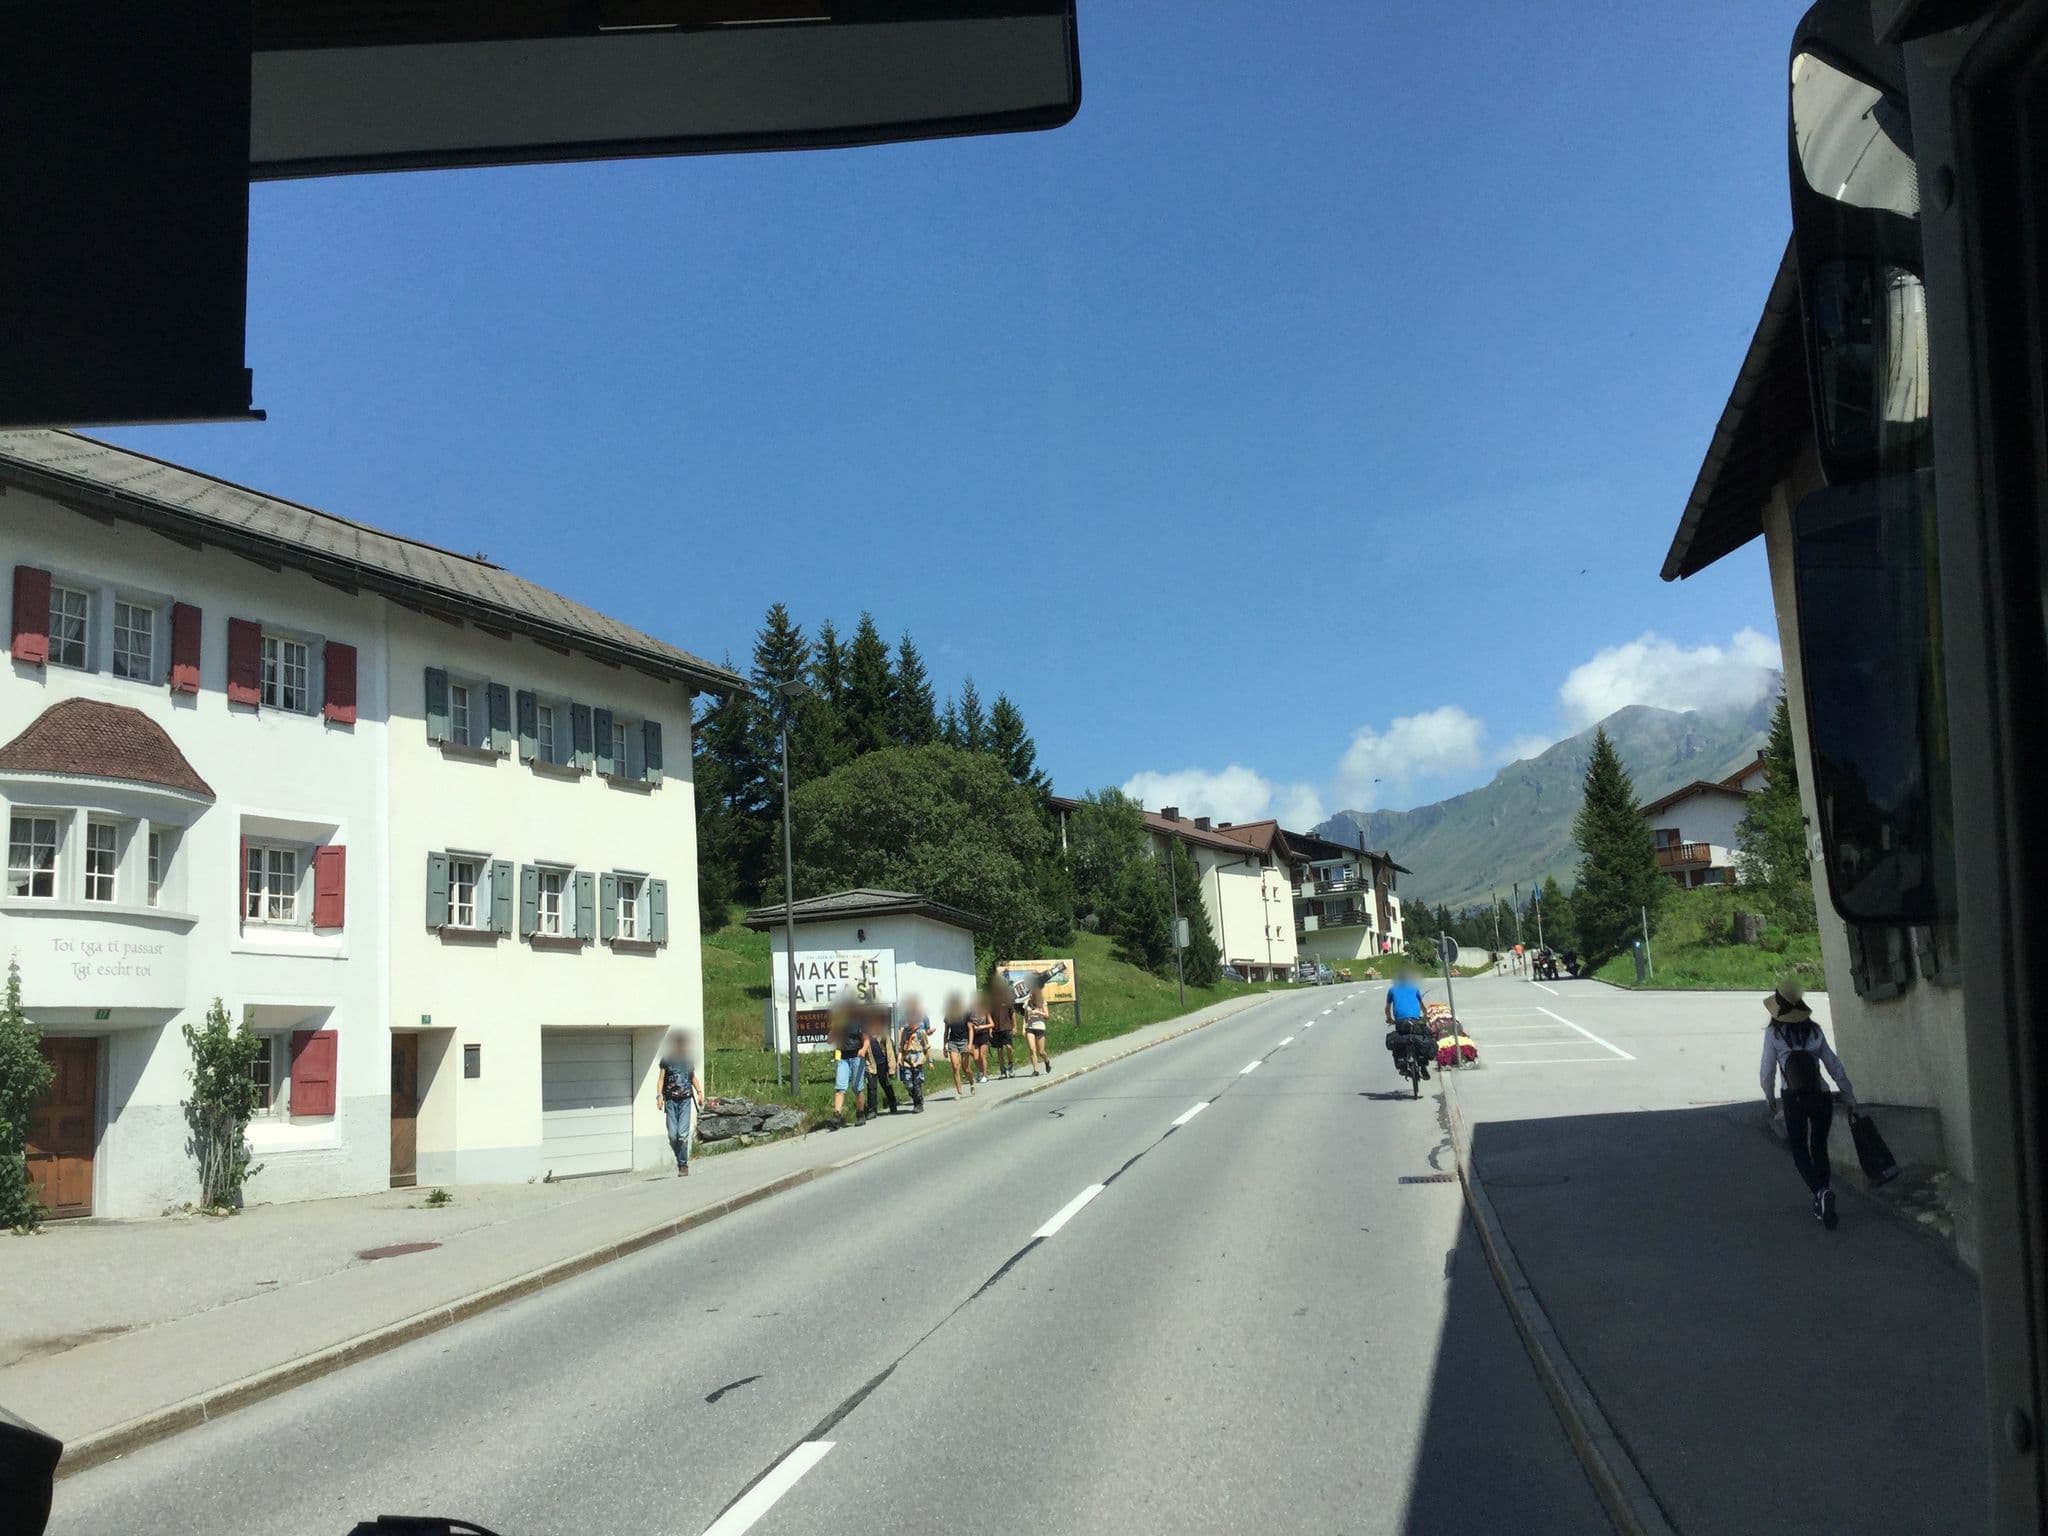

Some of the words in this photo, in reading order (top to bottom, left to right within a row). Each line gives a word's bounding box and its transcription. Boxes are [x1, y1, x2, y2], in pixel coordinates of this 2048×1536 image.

[51, 938, 74, 952] Toi
[793, 961, 849, 980] MAKE
[861, 960, 878, 980] IT
[794, 985, 806, 1003] A
[815, 982, 878, 1002] FEST
